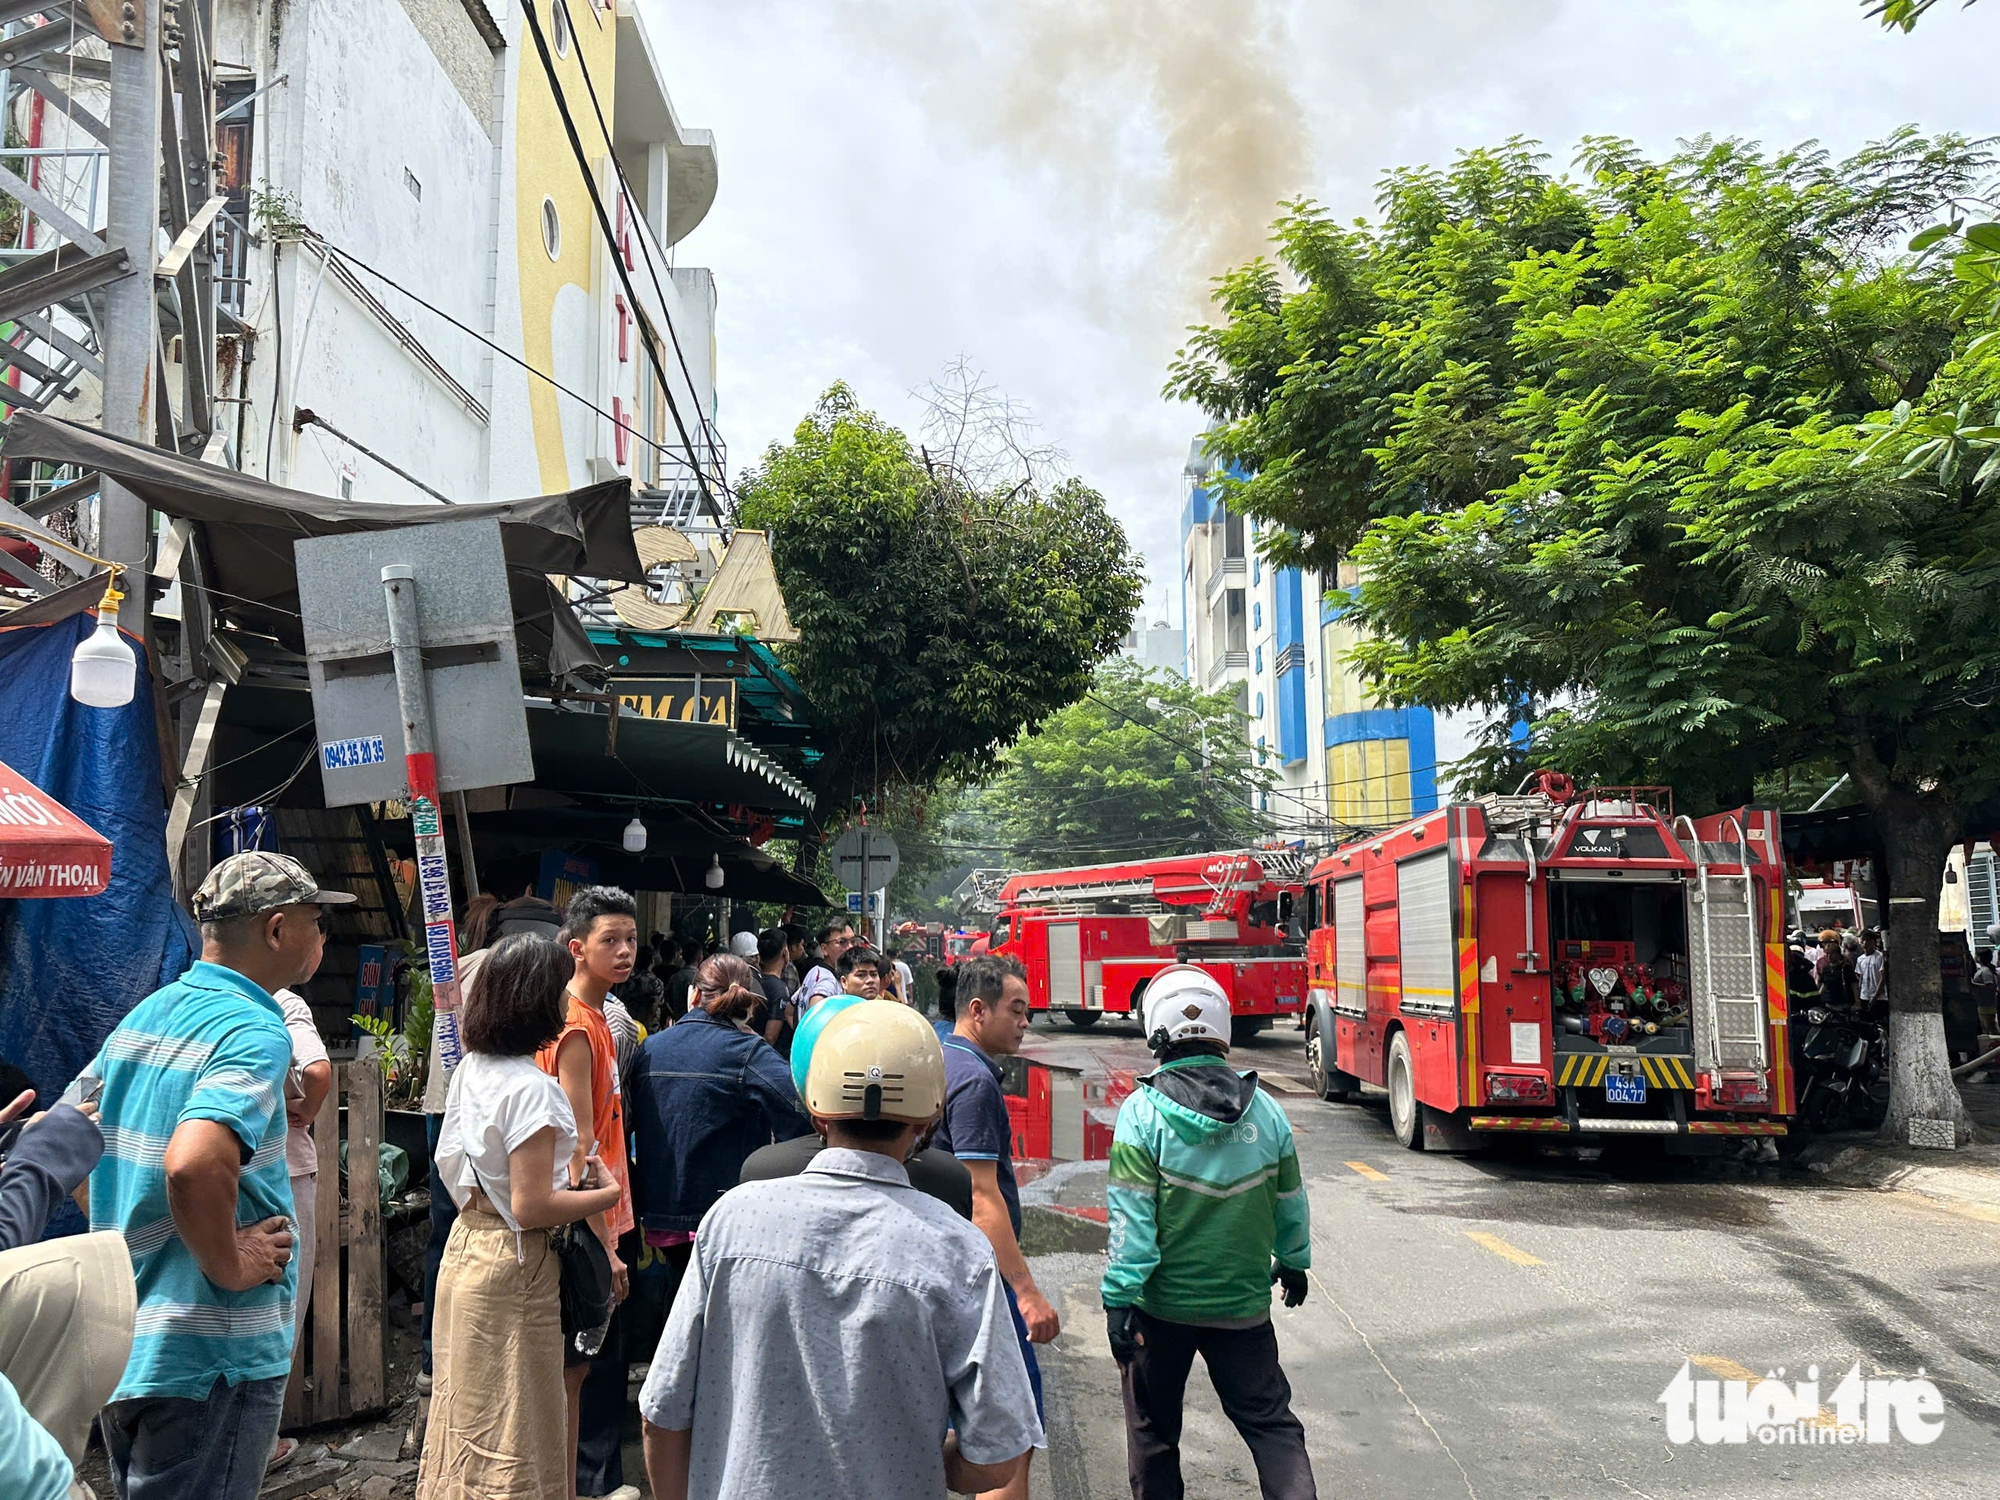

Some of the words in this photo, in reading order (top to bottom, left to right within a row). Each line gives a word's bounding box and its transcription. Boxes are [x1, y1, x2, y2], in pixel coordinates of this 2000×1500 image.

[325, 739, 384, 769] 0942.35.20.35
[1574, 845, 1612, 853] VOLKAN
[14, 859, 46, 888] VĂN
[48, 864, 99, 892] THOẠI
[361, 957, 381, 988] BÚN
[1615, 1076, 1636, 1089] 43A
[1608, 1088, 1644, 1102] 004.77
